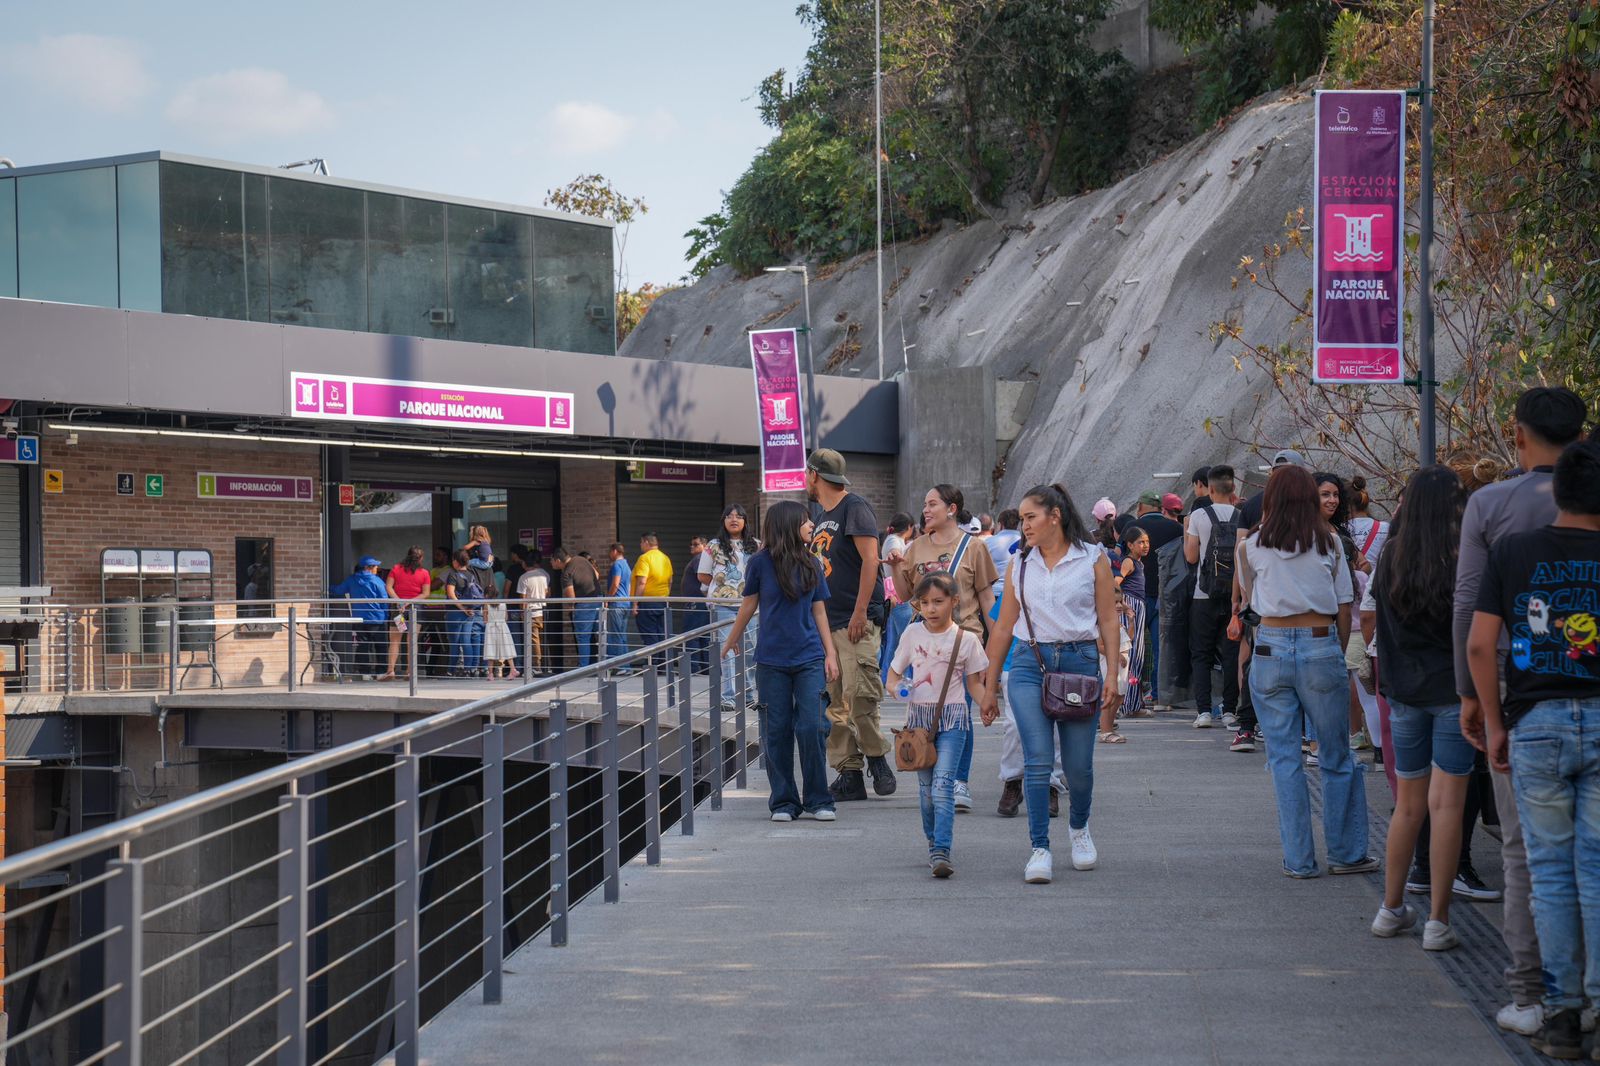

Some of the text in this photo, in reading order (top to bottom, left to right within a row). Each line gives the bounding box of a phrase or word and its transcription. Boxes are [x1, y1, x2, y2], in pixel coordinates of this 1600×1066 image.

[1324, 187, 1394, 197] CERCANA
[1332, 279, 1383, 290] PARQUE
[1325, 290, 1390, 300] NACIONAL
[399, 400, 504, 420] PARQUE NACIONAL
[769, 433, 795, 441] PARQUE
[767, 439, 799, 447] NACIONAL
[229, 481, 283, 493] INFORMACIÓN
